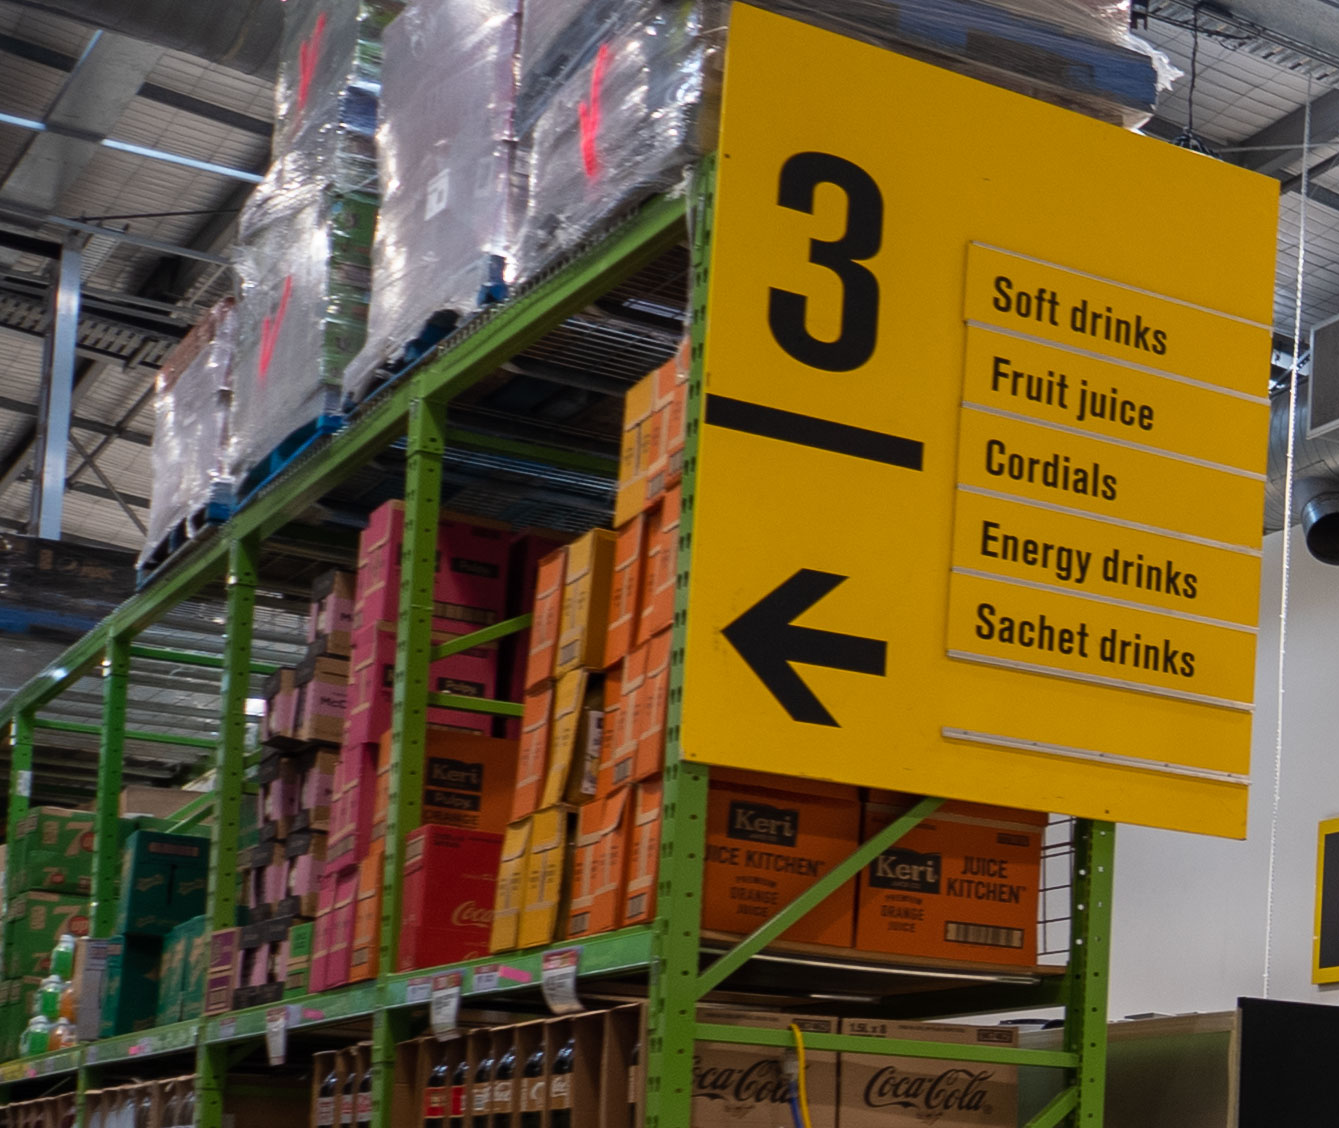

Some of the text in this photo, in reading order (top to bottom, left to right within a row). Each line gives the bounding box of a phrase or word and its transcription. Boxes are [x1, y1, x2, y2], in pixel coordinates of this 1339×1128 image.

[769, 152, 883, 372] 3
[994, 277, 1166, 354] Soft drinks
[993, 357, 1153, 430] Fruit juice
[987, 440, 1116, 500] Cordials
[982, 521, 1196, 598] Energy drinks
[977, 604, 1194, 677] Sachet drinks
[733, 808, 794, 837] Keri
[876, 855, 938, 883] Keri
[946, 877, 1020, 904] KITCHEN
[960, 855, 1008, 879] JUICE
[880, 904, 925, 921] ORANGE
[864, 1065, 994, 1112] Coca-Cola
